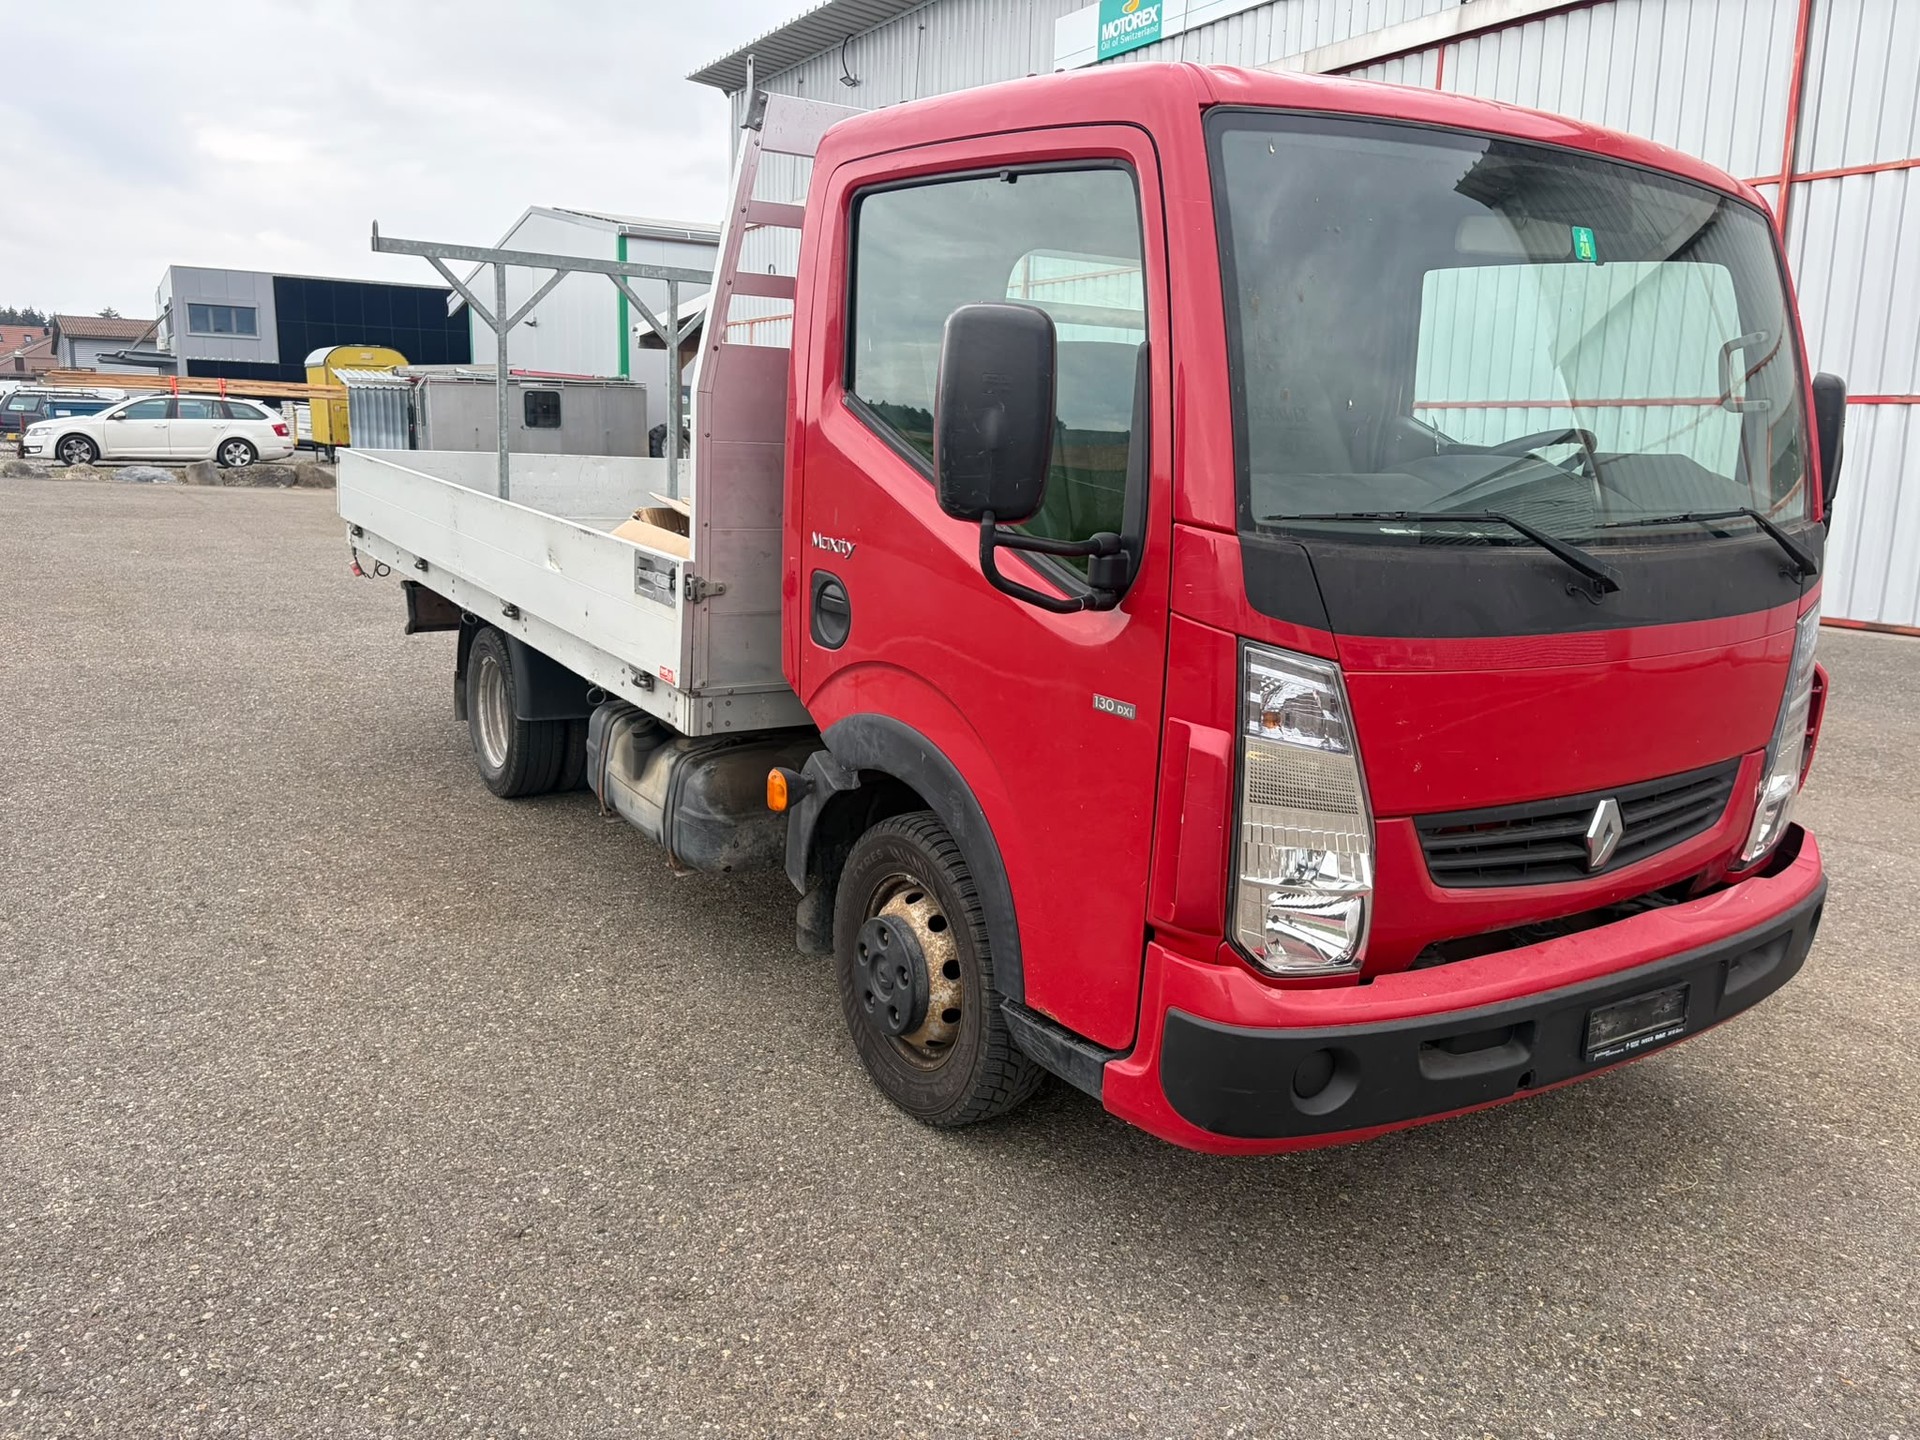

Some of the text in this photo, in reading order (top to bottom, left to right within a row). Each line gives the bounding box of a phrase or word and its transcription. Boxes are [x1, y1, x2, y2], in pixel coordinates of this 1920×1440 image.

[1101, 4, 1161, 42] MOTOREX
[1101, 22, 1159, 50] Oil of Switzerland
[811, 531, 857, 560] Maxity
[1094, 695, 1115, 712] 130
